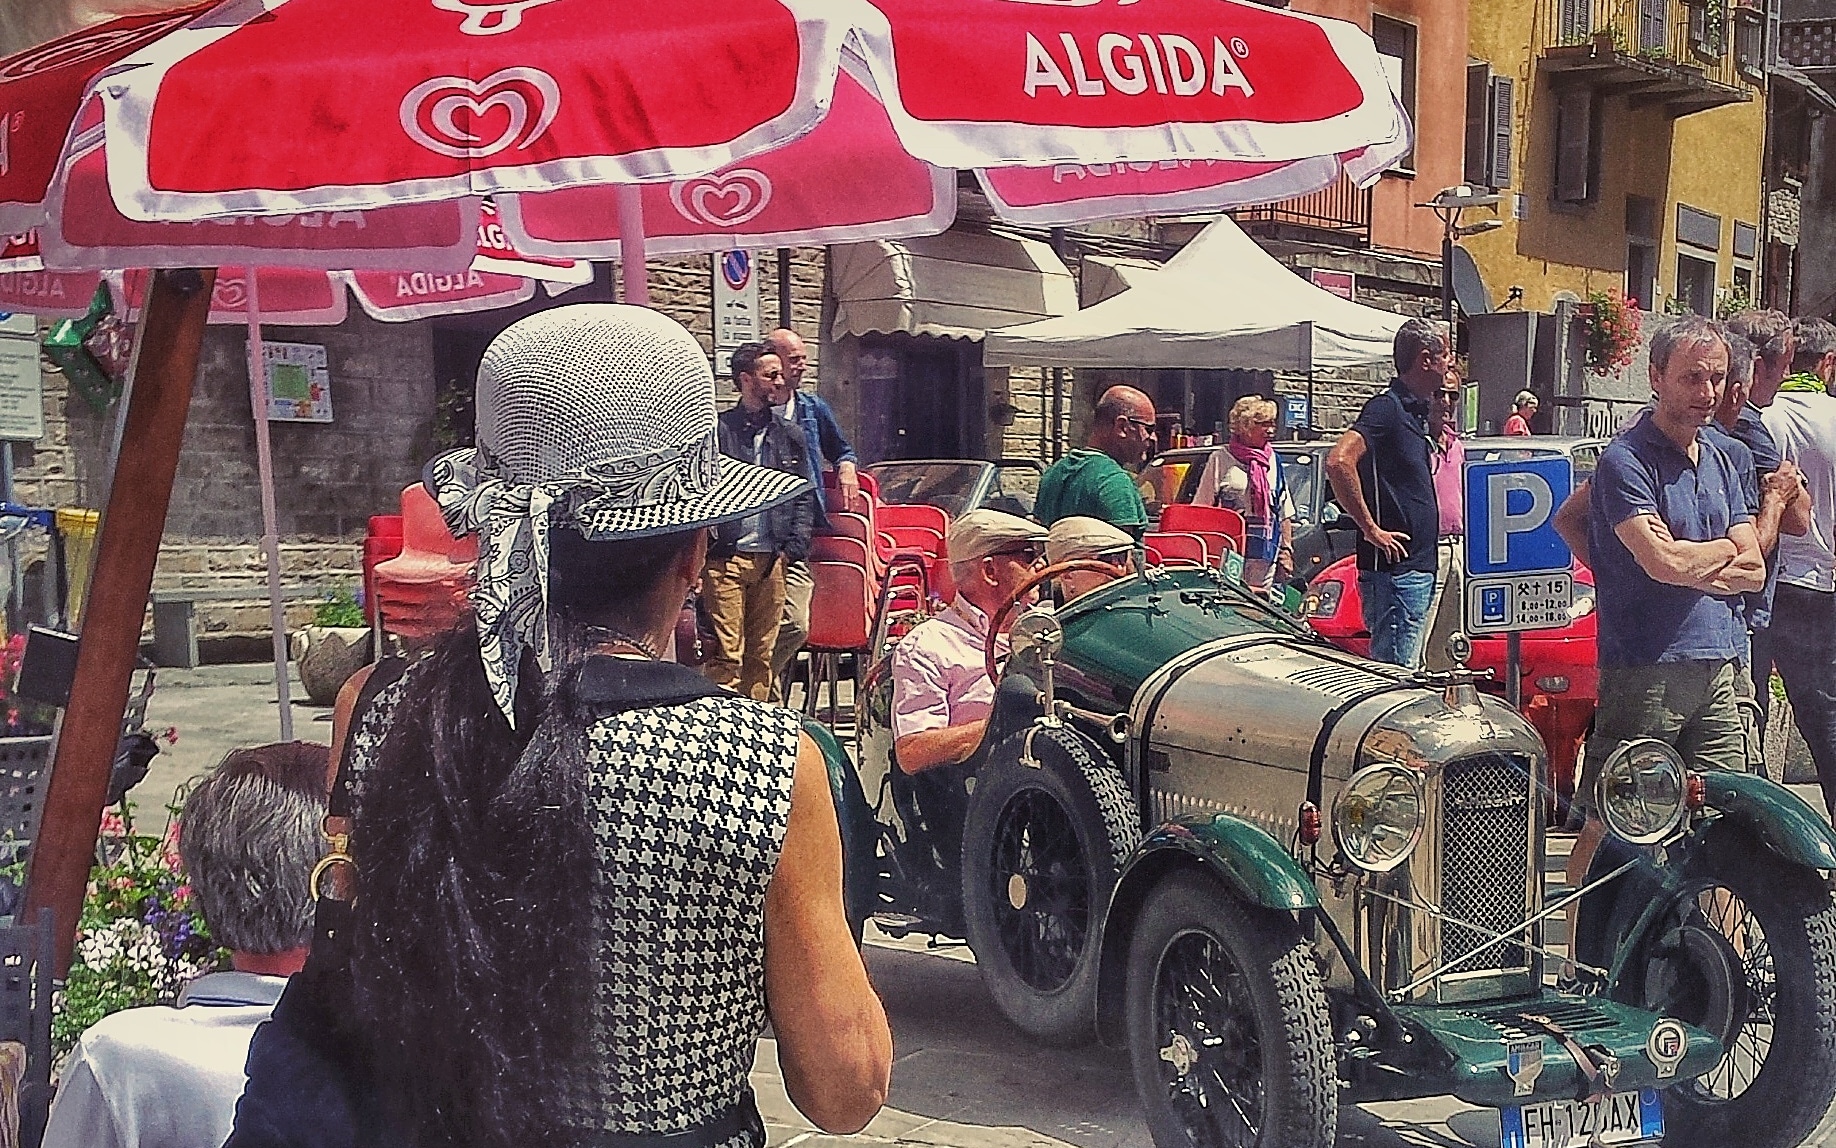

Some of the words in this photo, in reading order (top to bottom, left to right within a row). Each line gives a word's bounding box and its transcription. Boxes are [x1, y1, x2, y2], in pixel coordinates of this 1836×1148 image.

[1487, 472, 1553, 565] P
[1489, 592, 1498, 603] P
[1524, 1105, 1555, 1144] FH
[1611, 1094, 1639, 1132] AX
